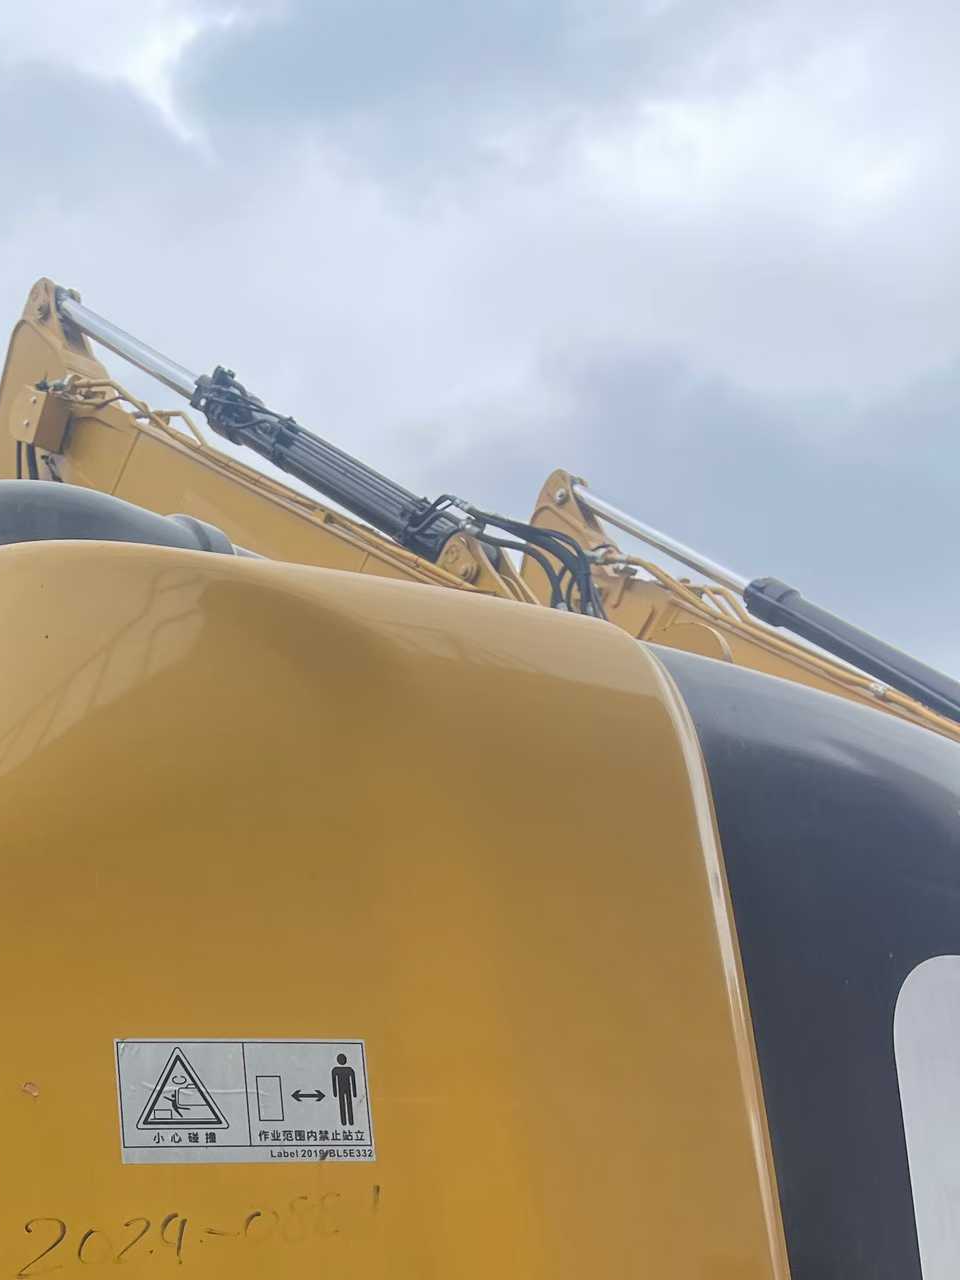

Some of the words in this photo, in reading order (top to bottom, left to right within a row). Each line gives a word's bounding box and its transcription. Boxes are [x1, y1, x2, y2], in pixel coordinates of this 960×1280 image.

[153, 1131, 217, 1144] 小心碰撞
[258, 1129, 366, 1142] 作业范围内禁止站立
